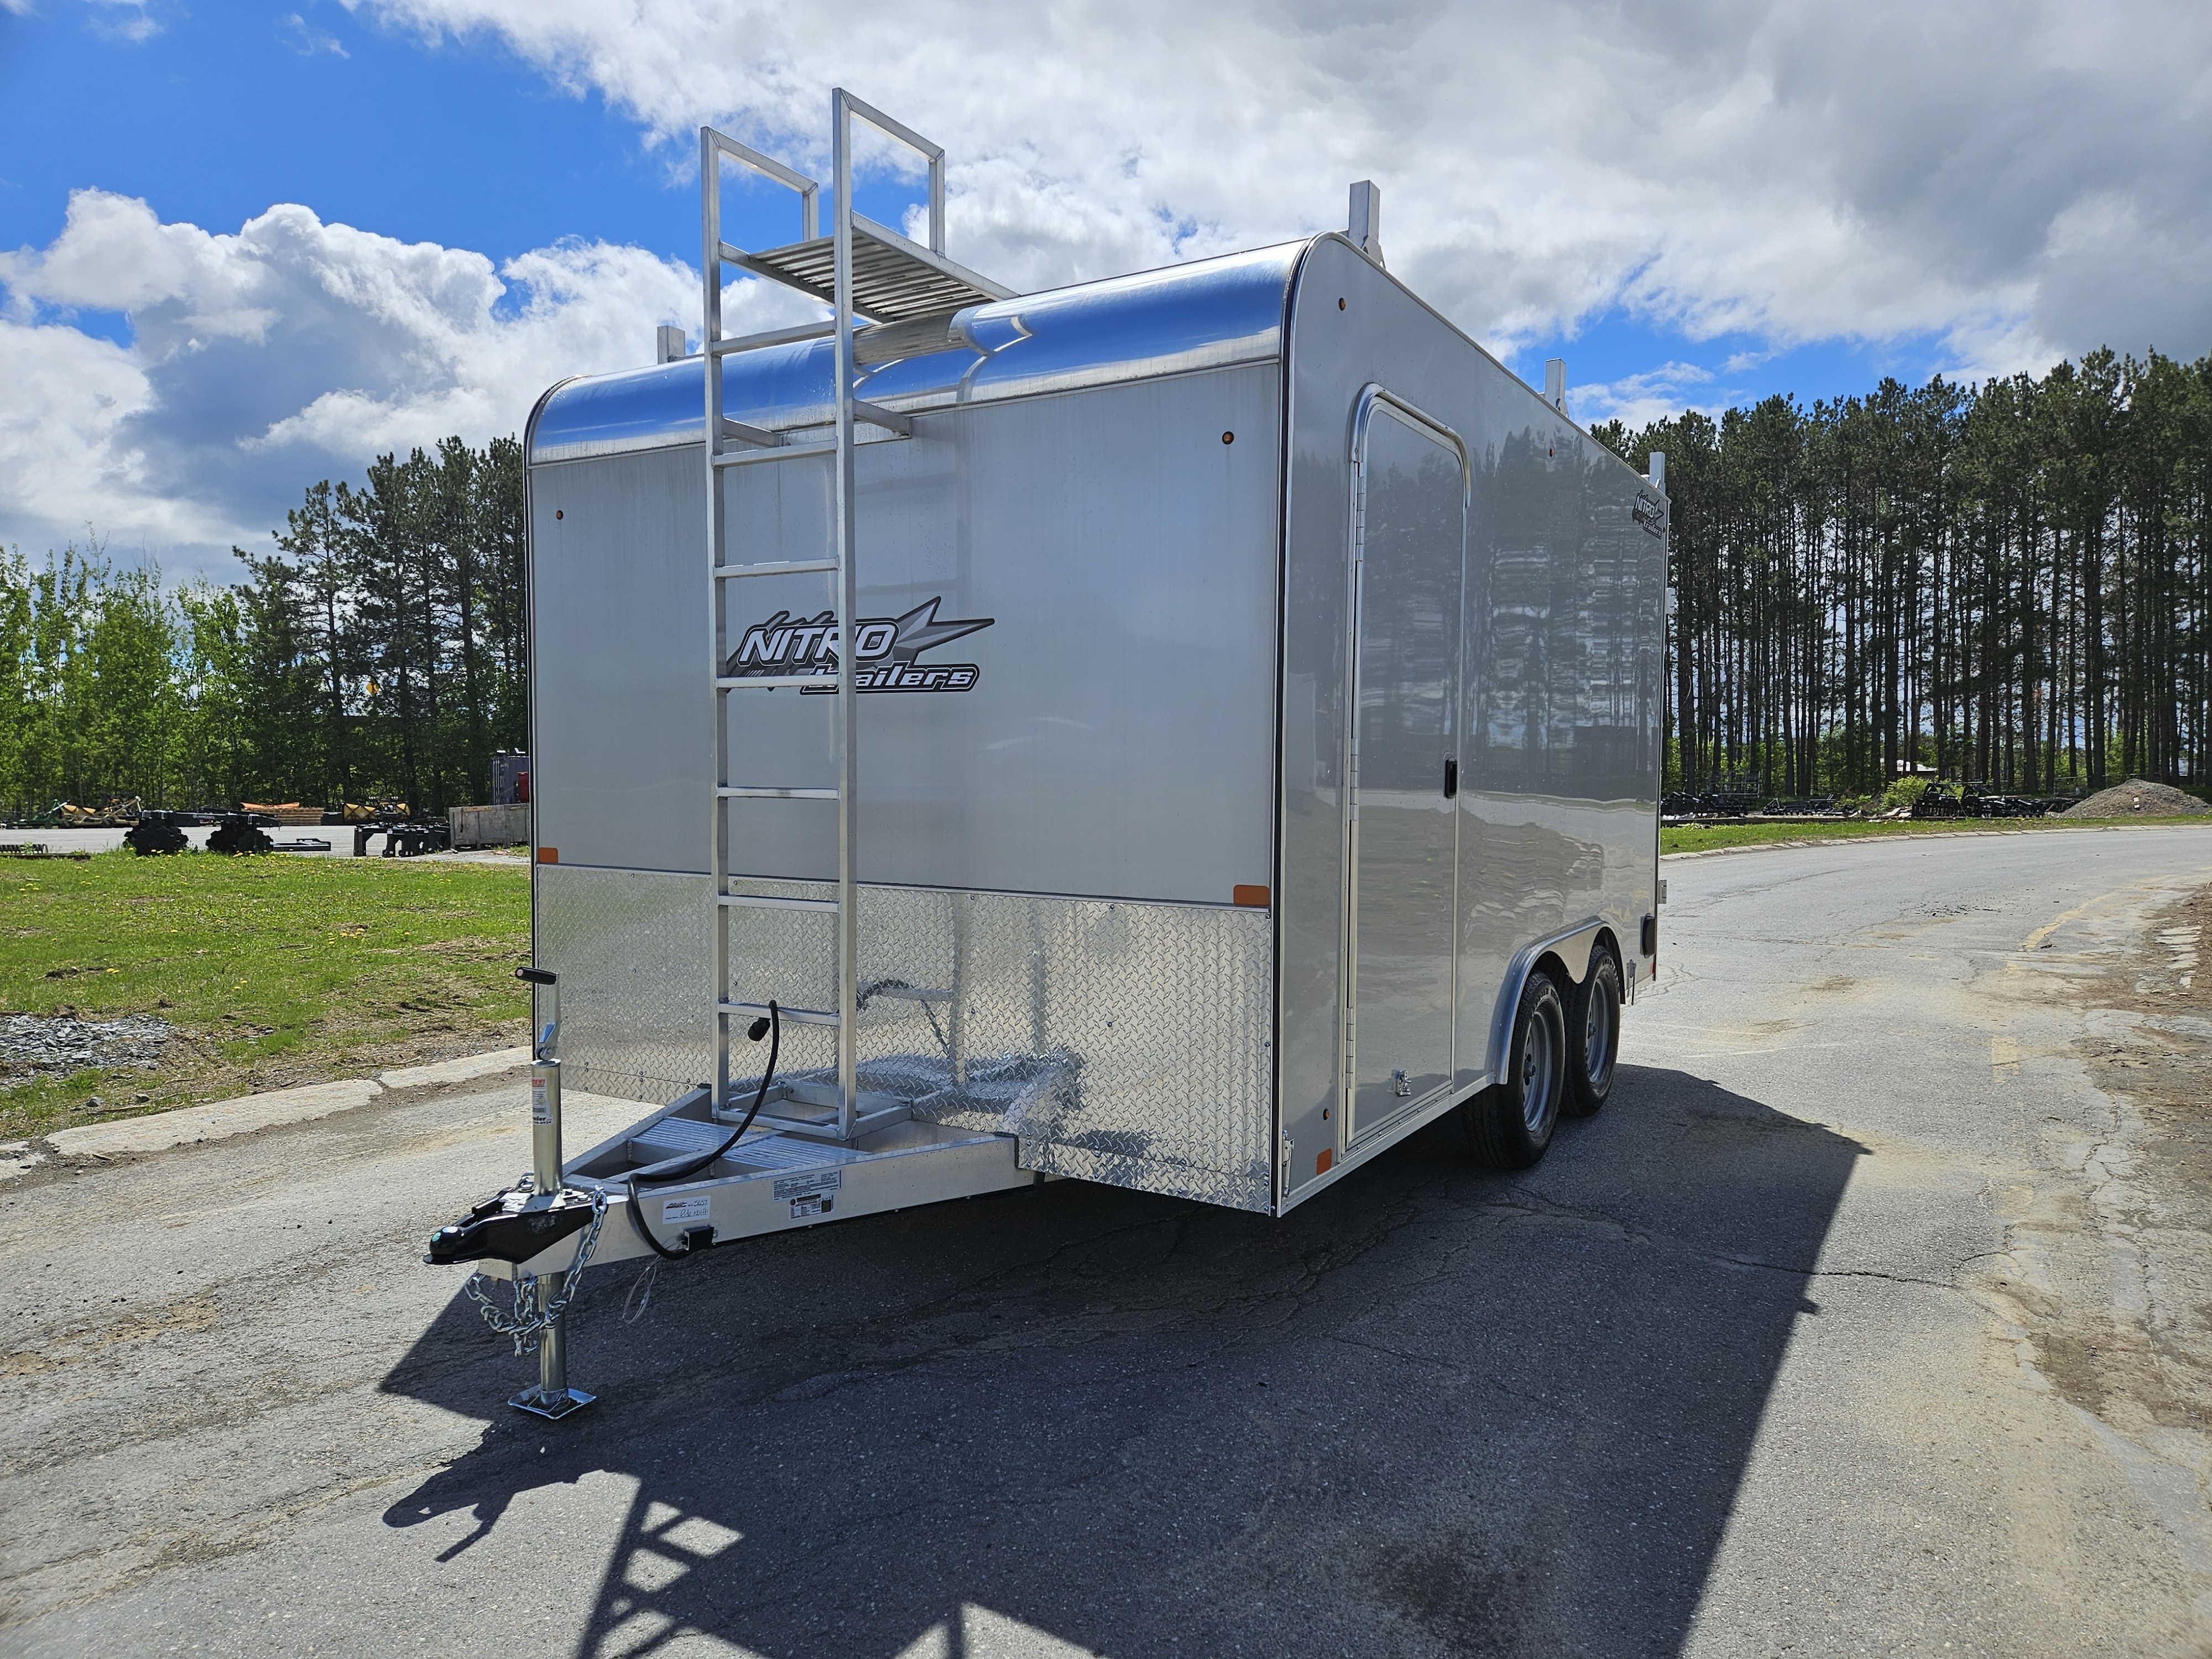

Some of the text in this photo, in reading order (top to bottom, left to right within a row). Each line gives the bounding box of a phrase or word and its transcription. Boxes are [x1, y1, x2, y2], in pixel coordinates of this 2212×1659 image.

[1635, 496, 1655, 518] NITRO
[1644, 519, 1661, 536] trailers
[808, 665, 975, 688] ailers
